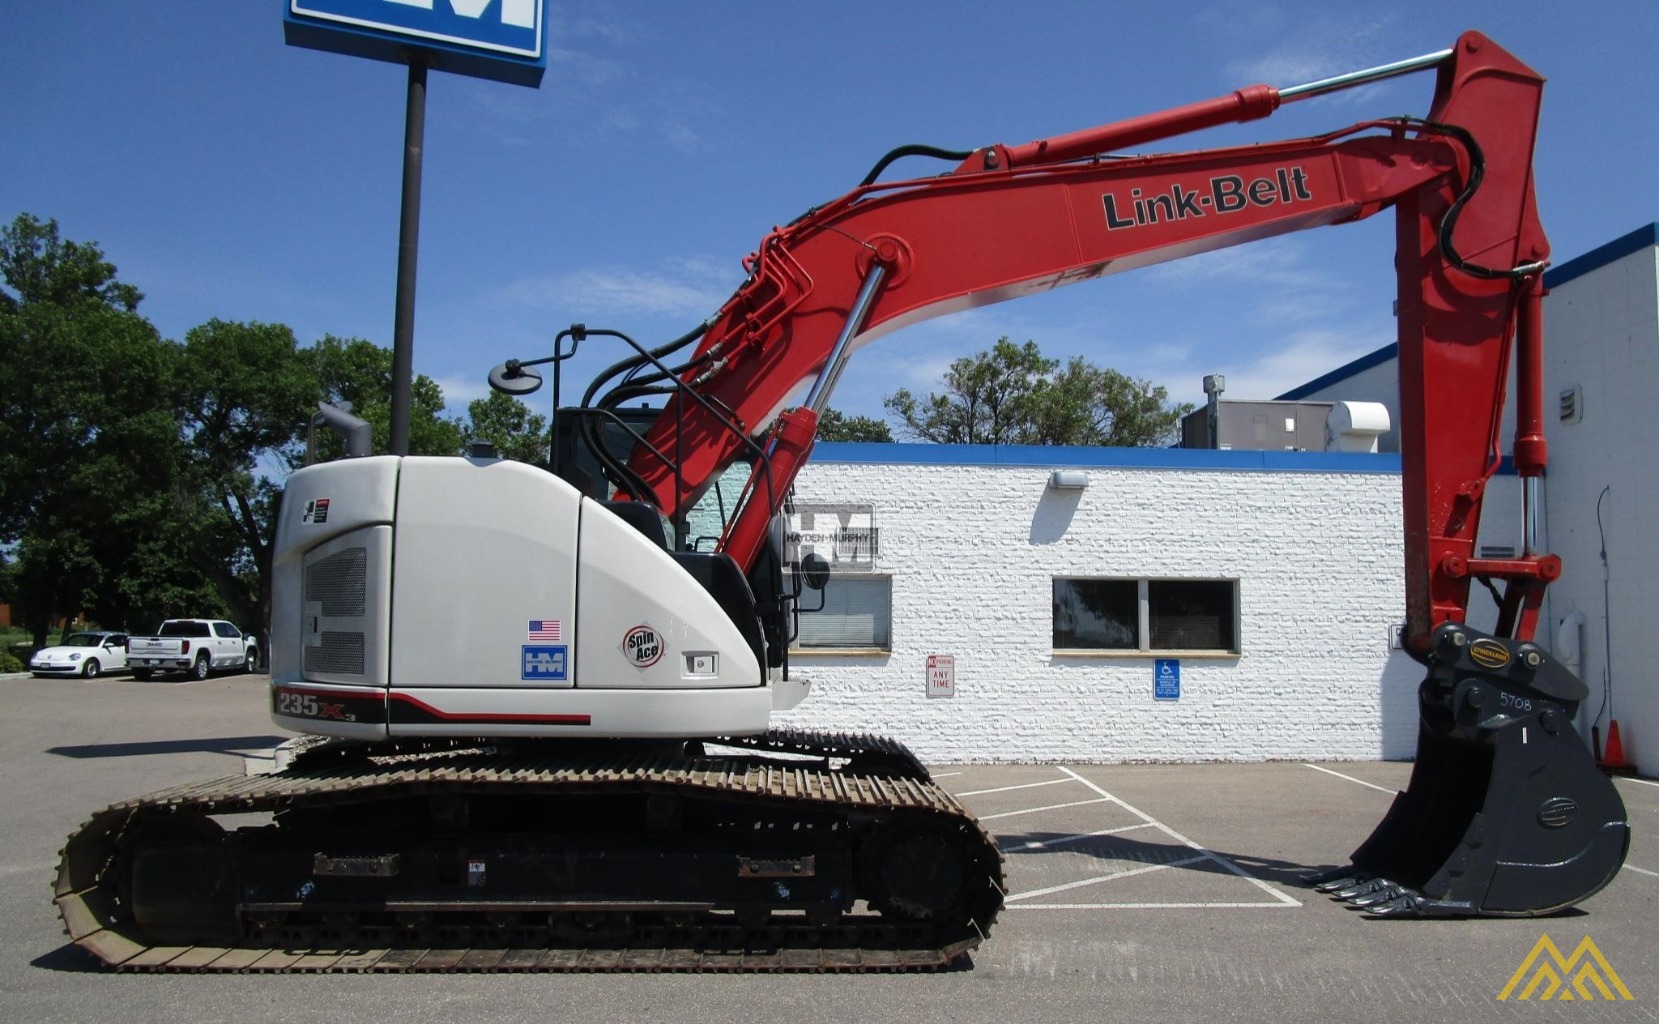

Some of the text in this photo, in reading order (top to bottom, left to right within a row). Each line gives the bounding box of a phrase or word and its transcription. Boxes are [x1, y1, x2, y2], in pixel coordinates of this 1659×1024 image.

[1101, 166, 1312, 231] Link-Belt
[629, 631, 654, 648] Spin
[636, 645, 659, 661] Ace
[526, 653, 563, 672] HM
[933, 671, 949, 679] ANY
[933, 679, 950, 688] TIME
[1500, 692, 1532, 711] 5708
